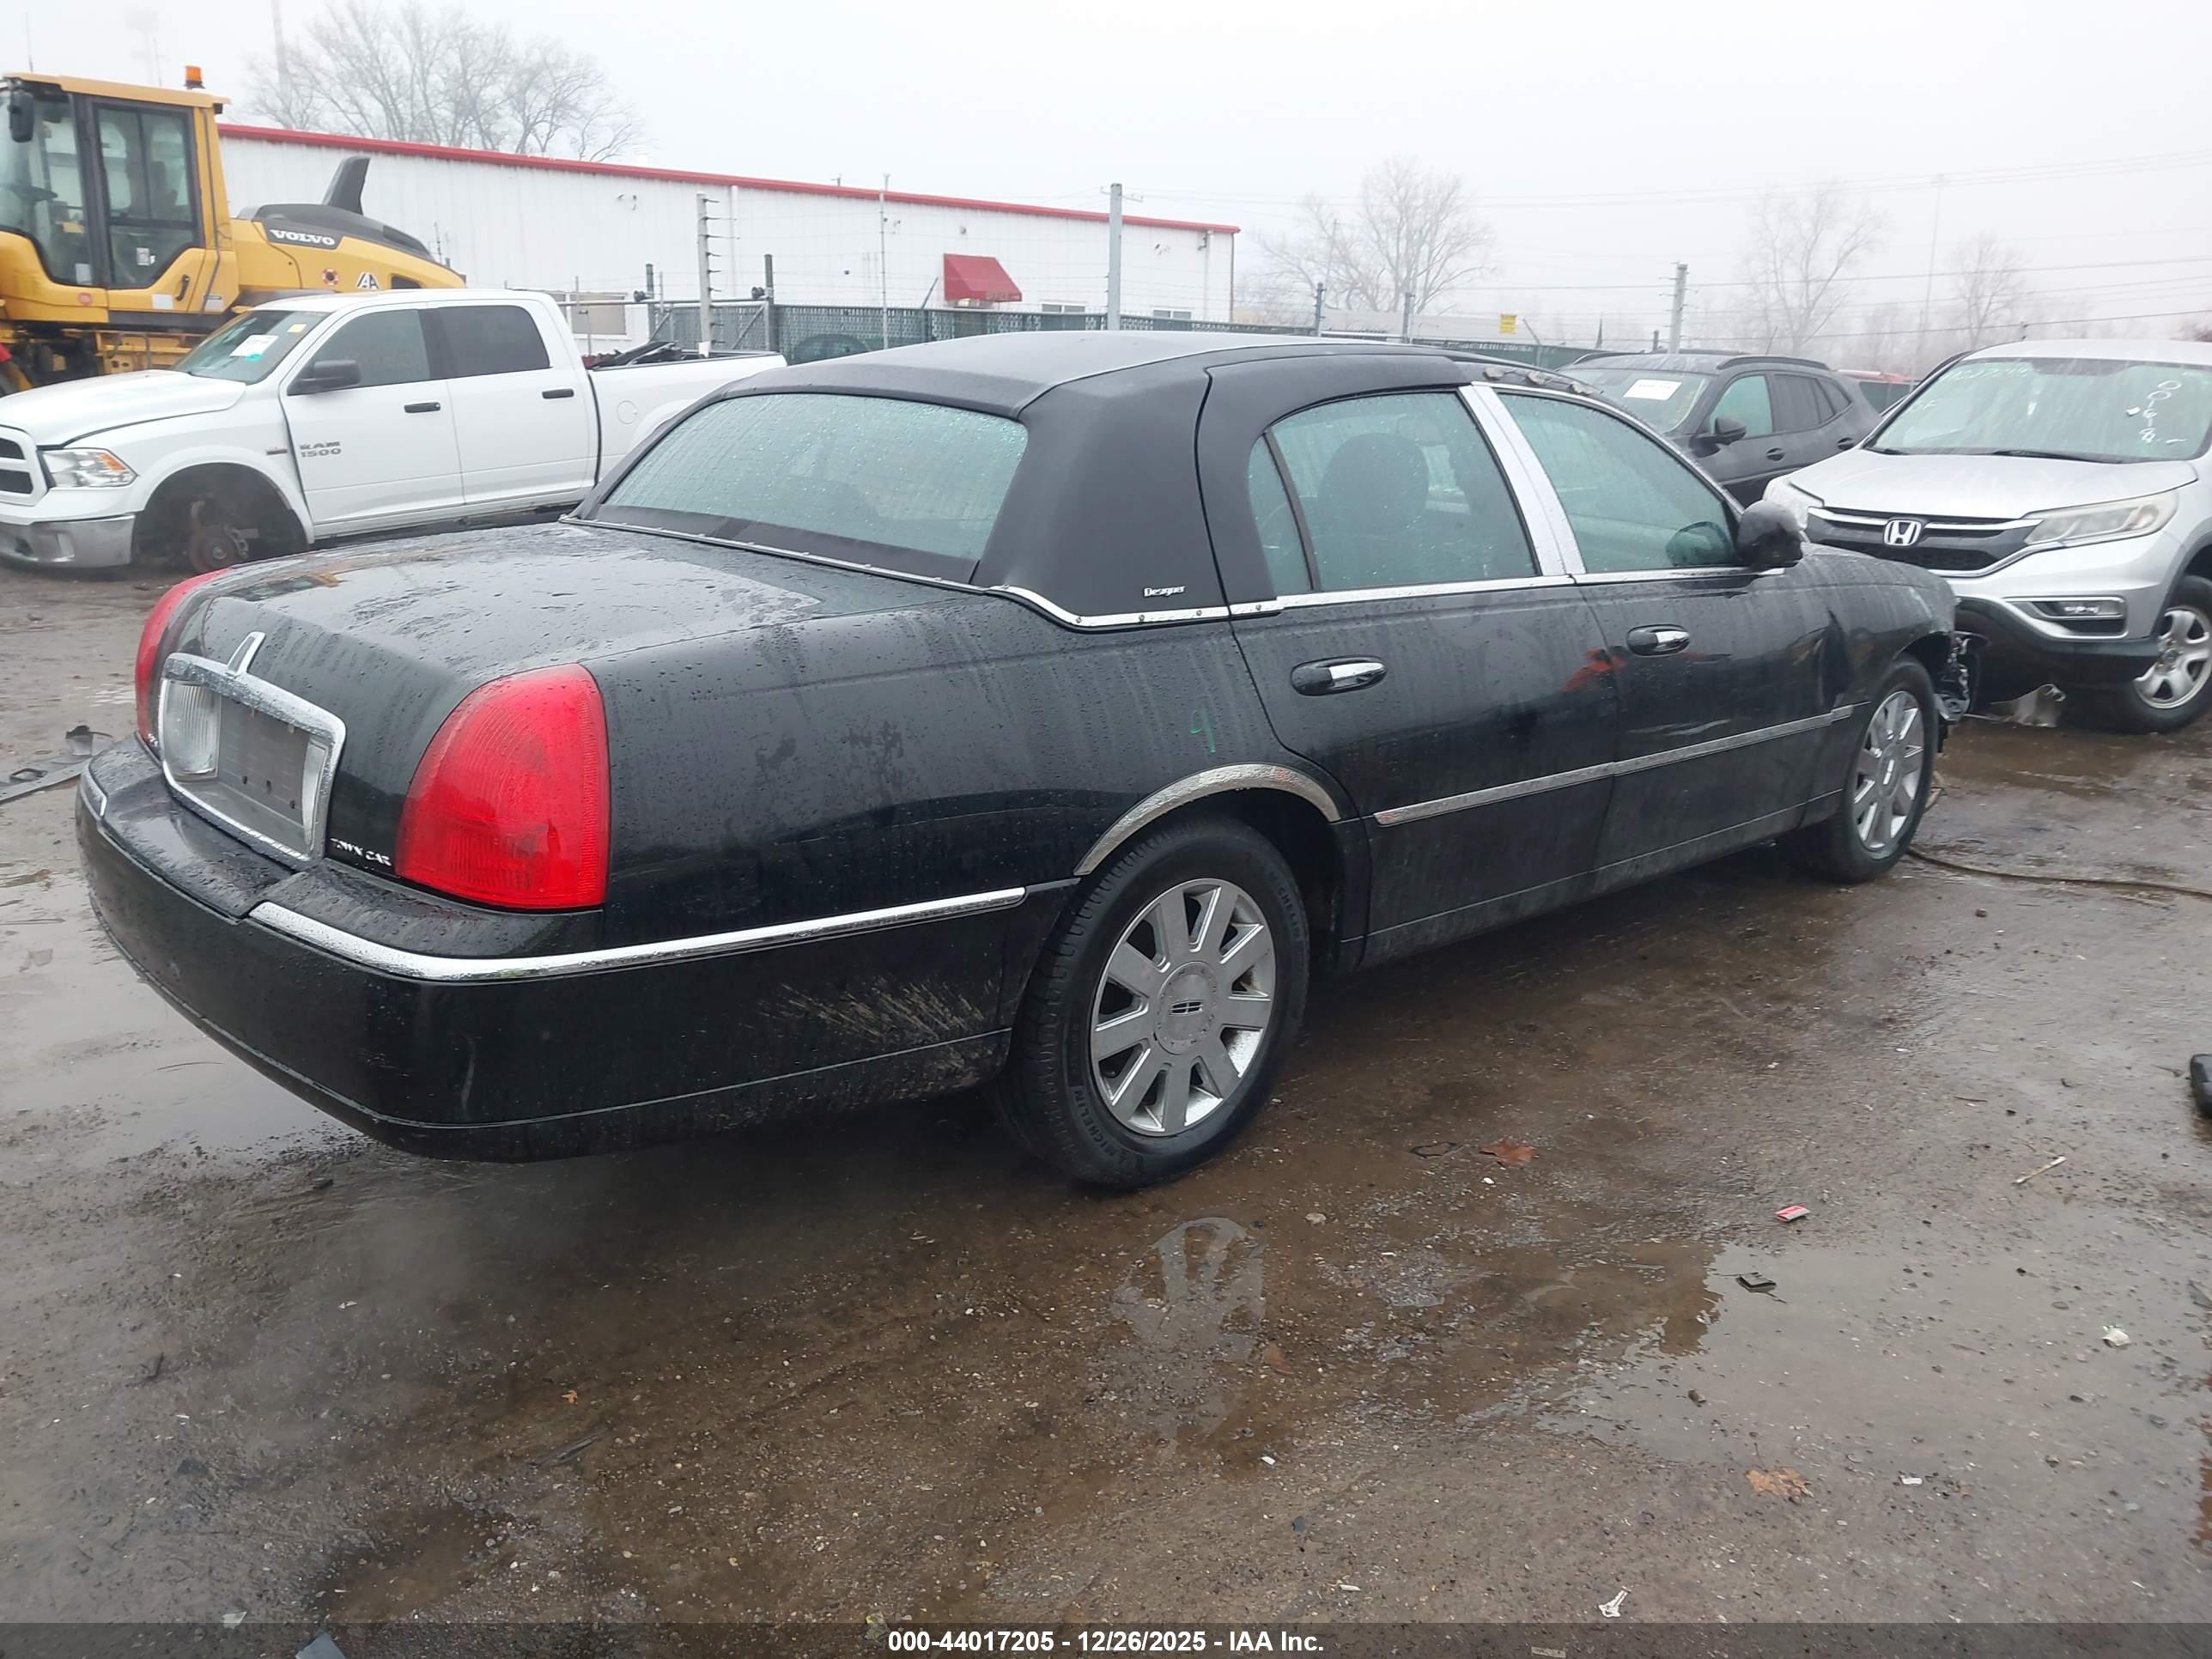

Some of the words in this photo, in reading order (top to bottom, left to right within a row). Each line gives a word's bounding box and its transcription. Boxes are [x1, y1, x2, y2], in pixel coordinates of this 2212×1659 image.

[269, 228, 336, 246] VOLVO
[299, 441, 341, 450] RAM
[301, 448, 342, 458] 1500
